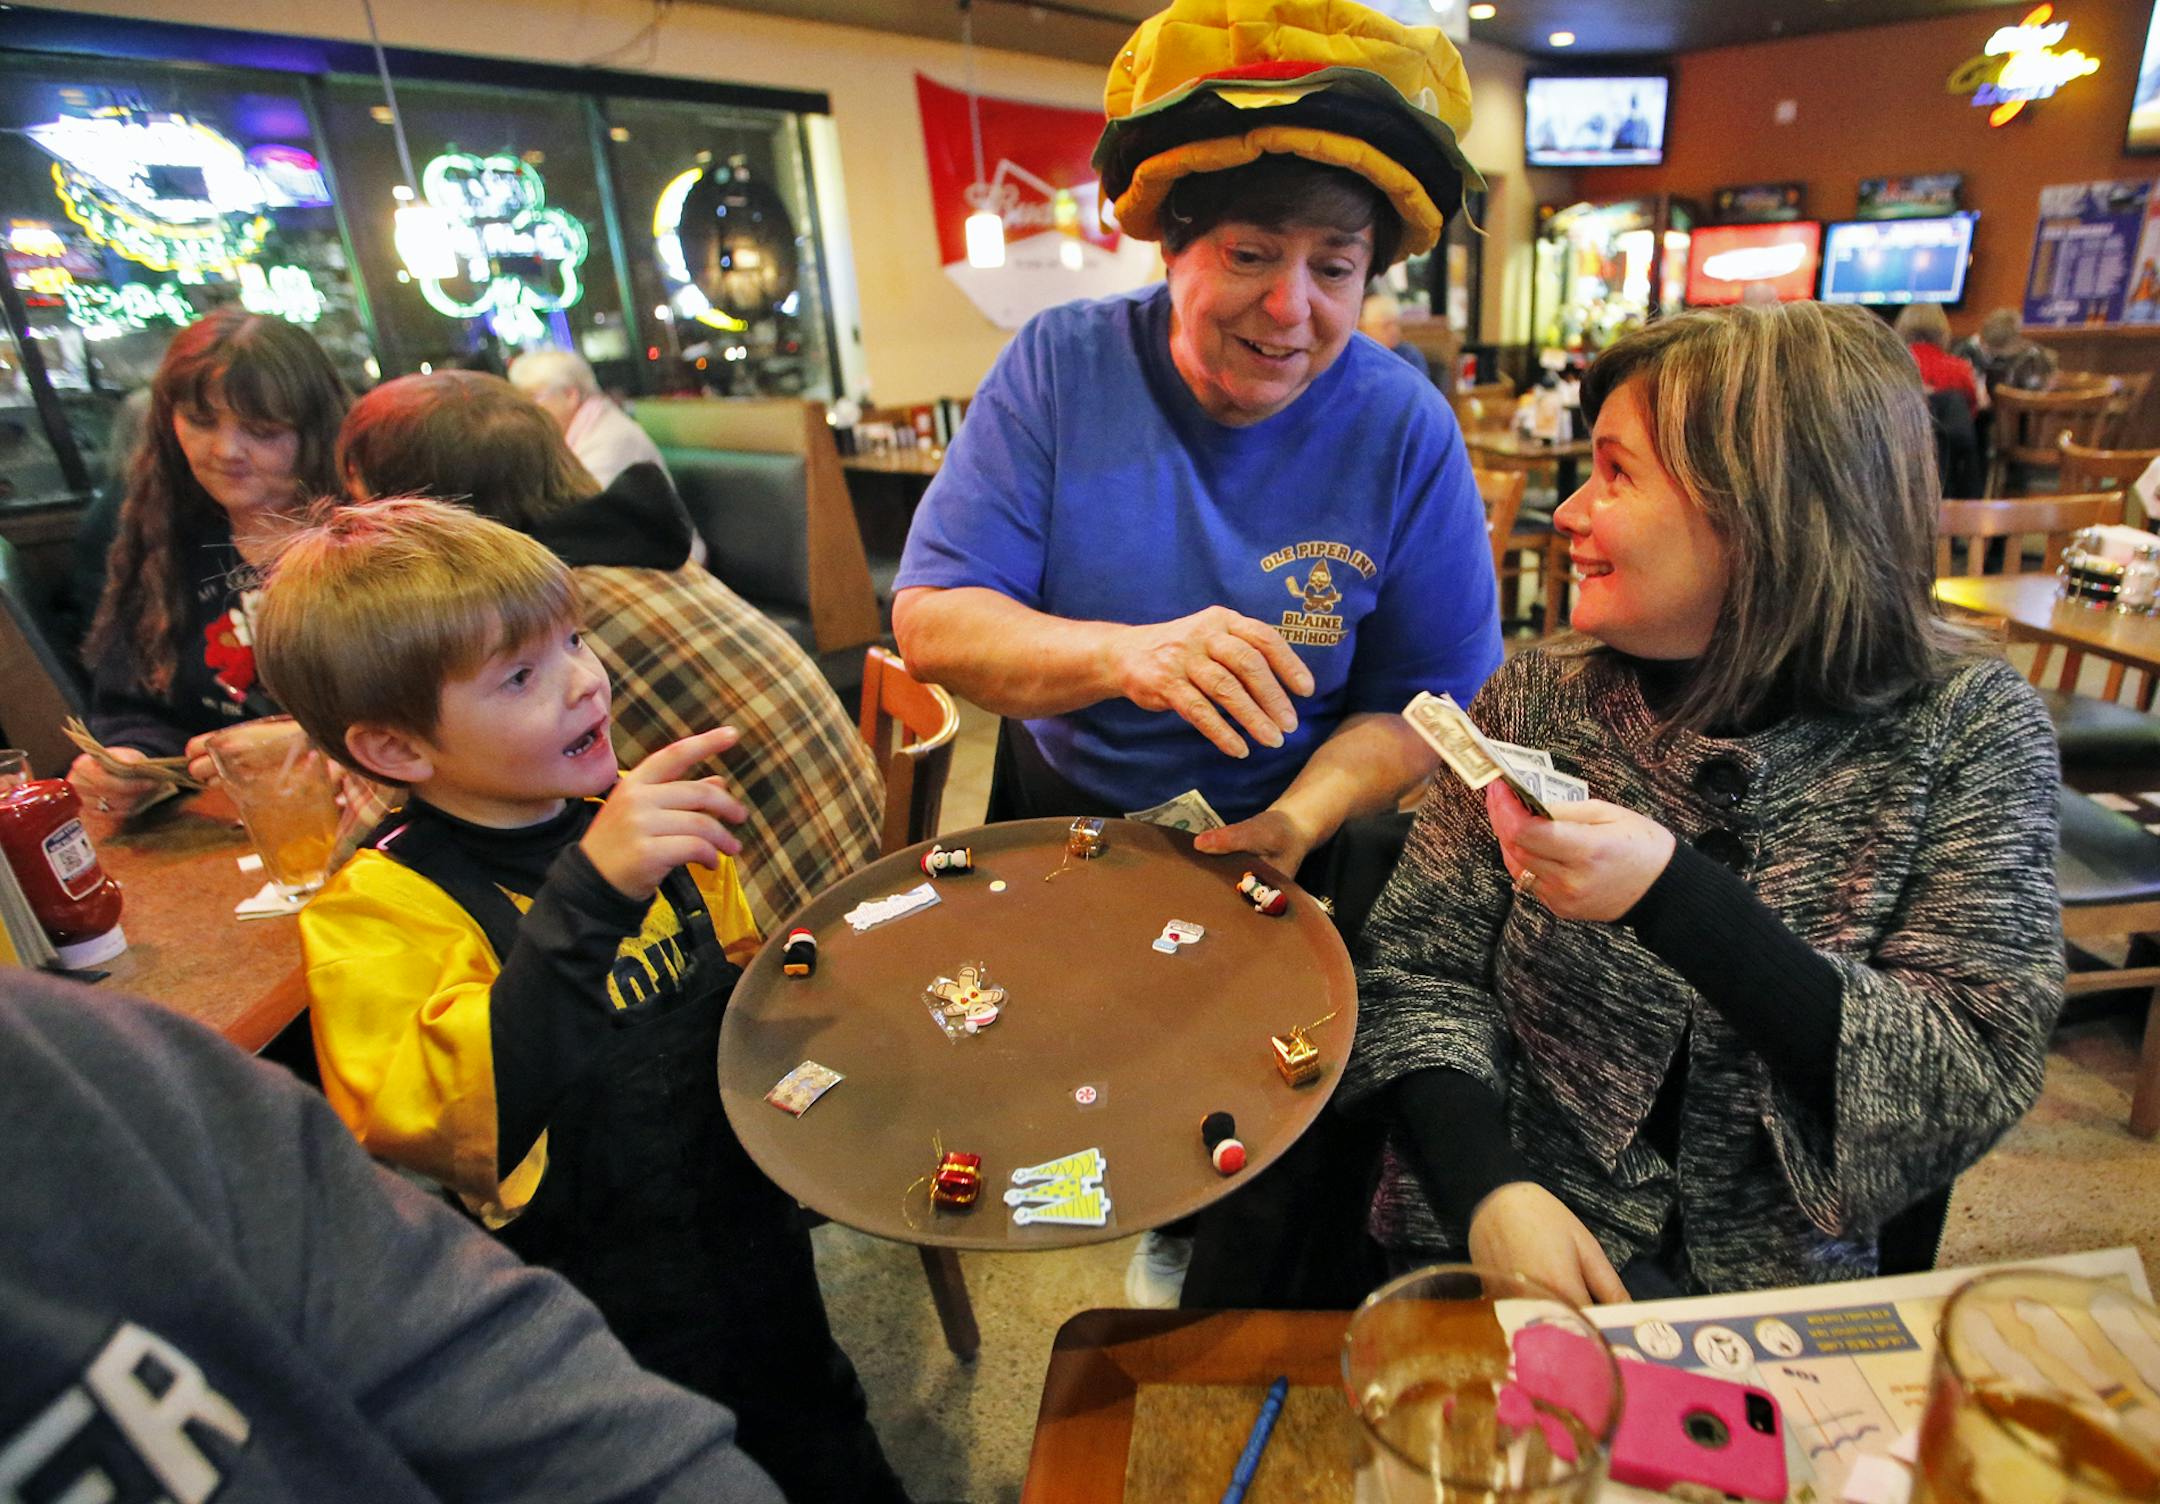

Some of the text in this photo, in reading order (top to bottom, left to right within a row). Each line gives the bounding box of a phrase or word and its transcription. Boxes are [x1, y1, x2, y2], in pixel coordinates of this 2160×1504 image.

[1260, 540, 1377, 580] OLE PIPER INN
[1282, 610, 1343, 630] BLAINE
